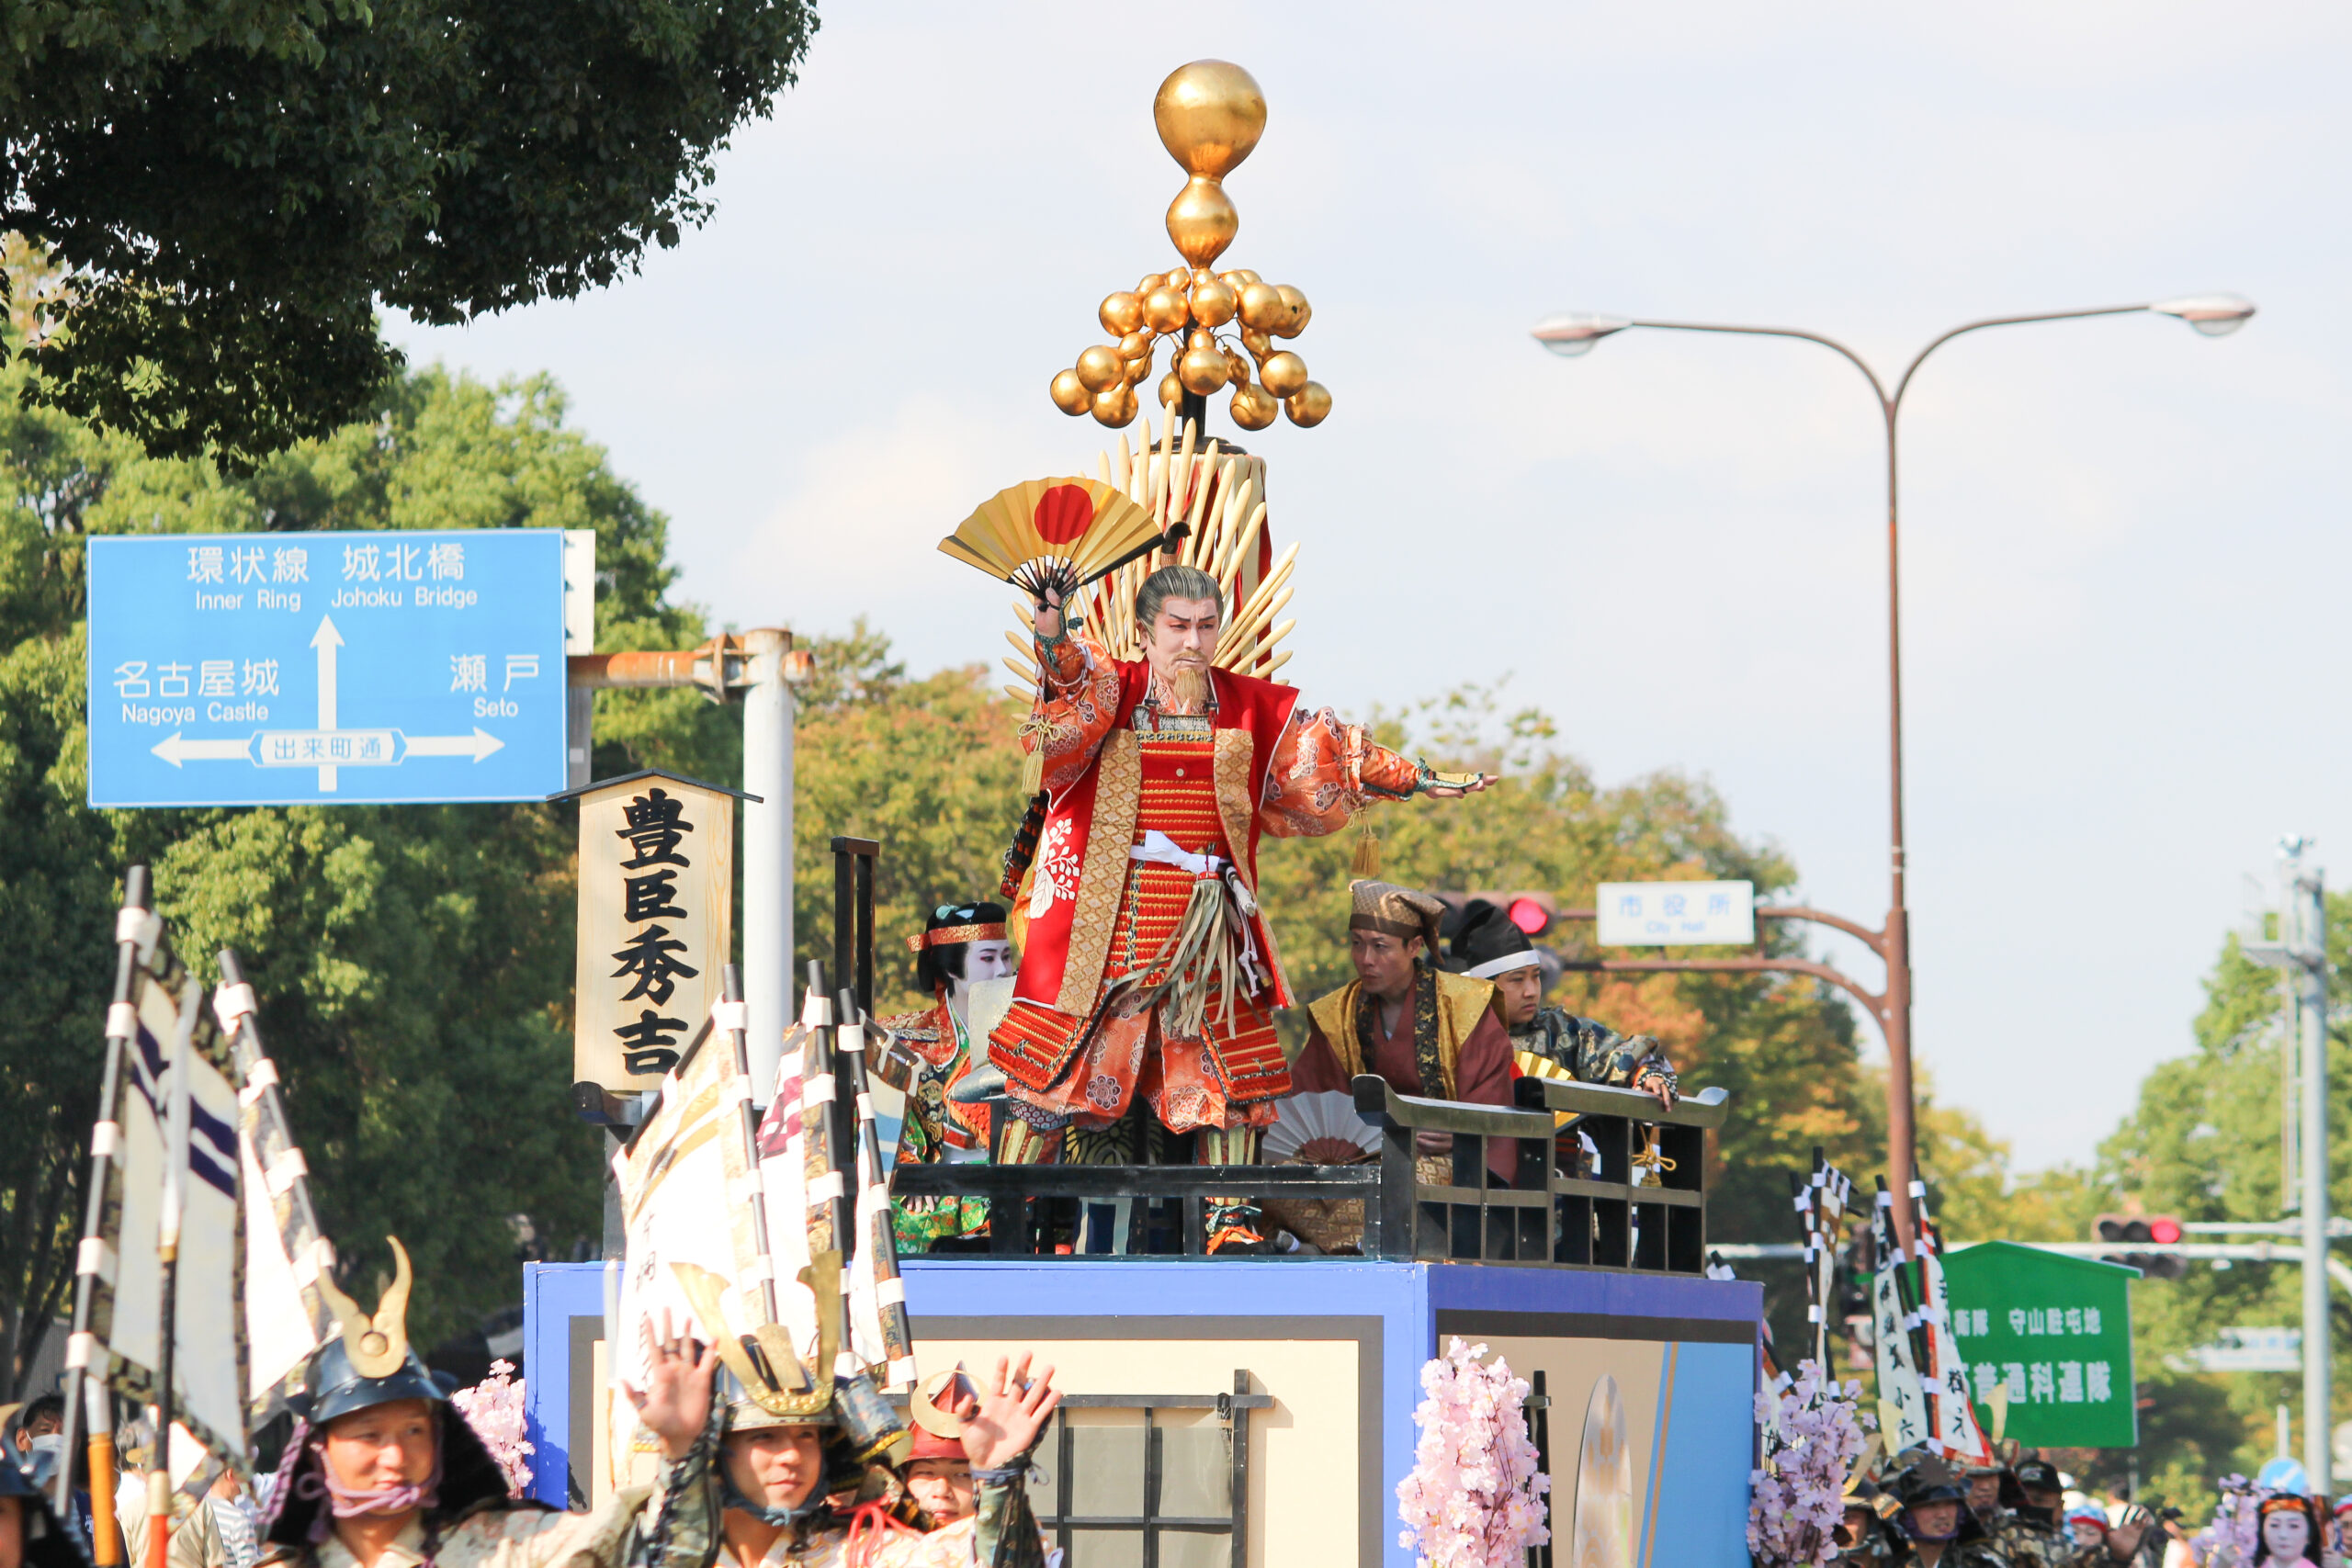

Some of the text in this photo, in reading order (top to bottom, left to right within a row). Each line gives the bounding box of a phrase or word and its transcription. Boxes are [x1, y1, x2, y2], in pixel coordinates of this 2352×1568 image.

[187, 546, 311, 585] 環状線
[341, 543, 466, 583] 城北橋
[196, 590, 302, 613] Inner Ring
[331, 586, 478, 610] Johoku Bridge
[113, 658, 280, 699] 名古屋城
[449, 654, 540, 693] 瀬戸
[122, 702, 270, 727] Nagoya Castle
[474, 697, 520, 717] Seto
[274, 737, 382, 761] 出来町通
[1619, 893, 1732, 918] 市役所
[609, 787, 699, 1076] 豊臣秀吉
[1645, 920, 1706, 934] City Hall
[1962, 1360, 2112, 1404] 普通科連隊
